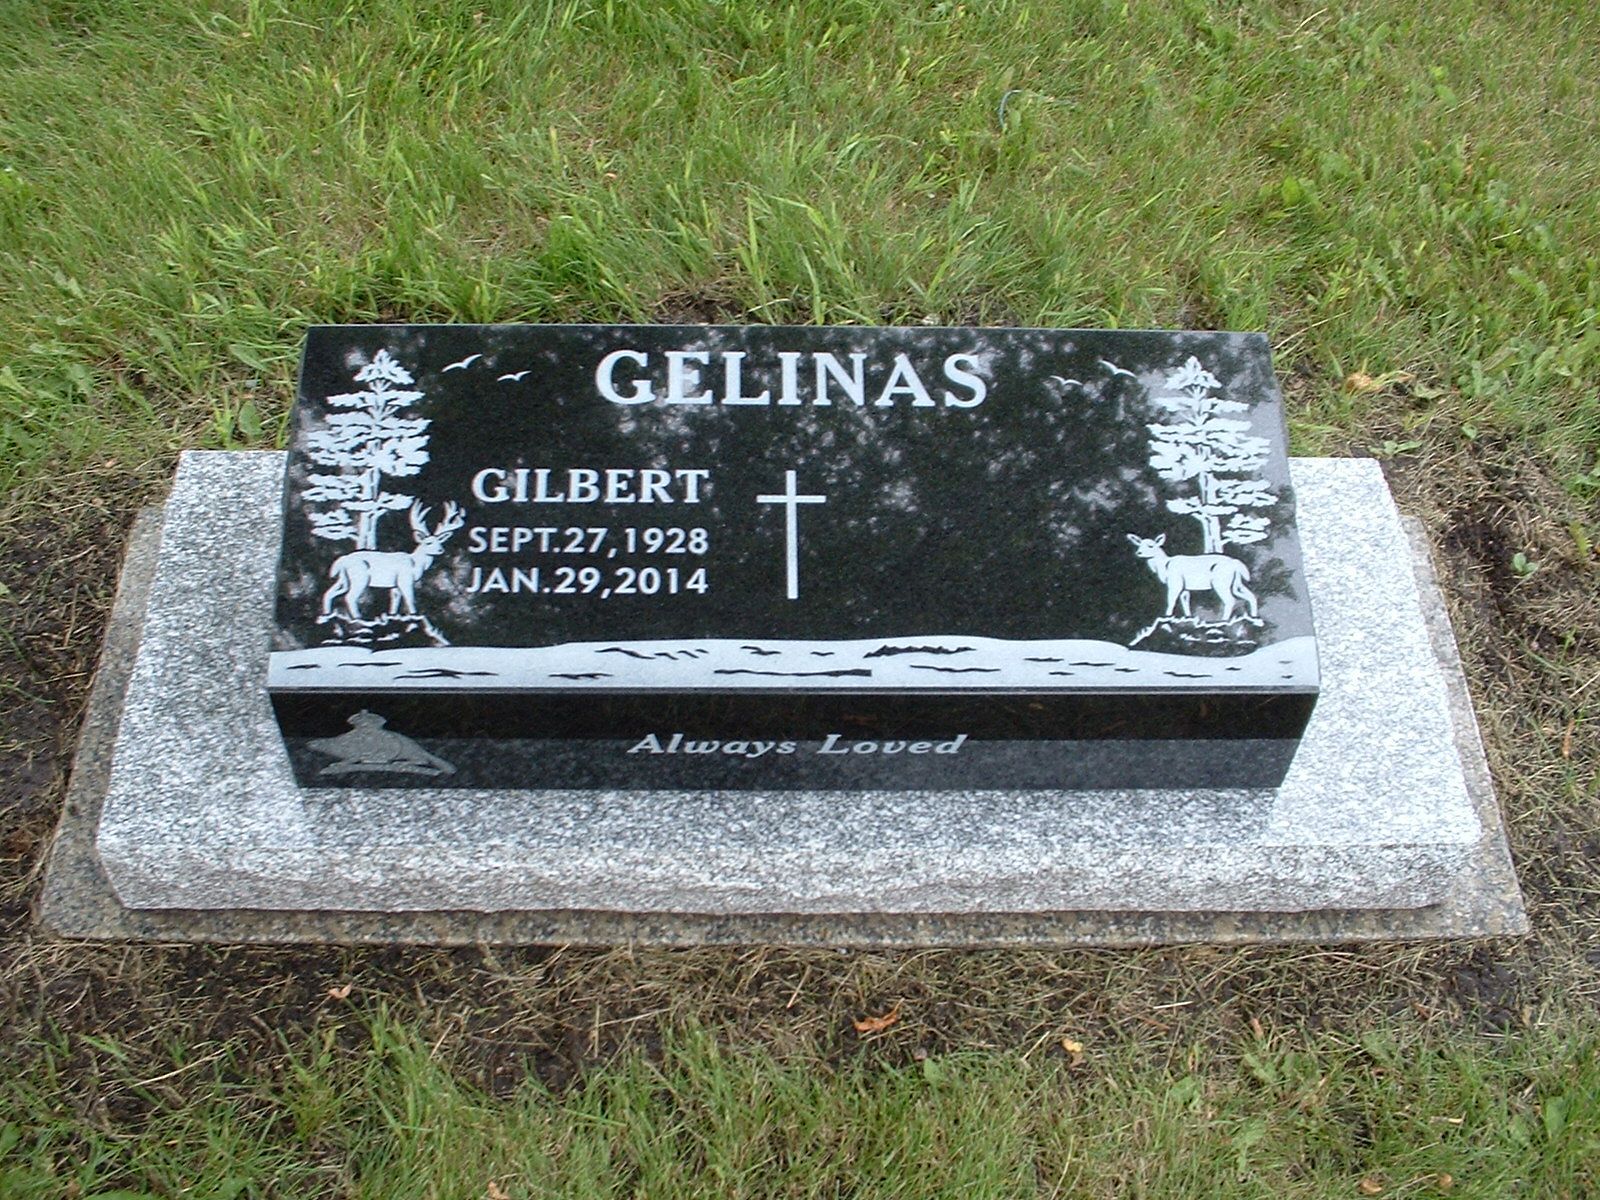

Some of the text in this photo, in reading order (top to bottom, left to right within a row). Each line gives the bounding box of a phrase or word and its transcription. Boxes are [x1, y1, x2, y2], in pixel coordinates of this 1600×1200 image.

[595, 350, 988, 409] GELINAS
[471, 468, 711, 504] GILBERT
[468, 526, 710, 559] SEPT.27,1928
[466, 566, 709, 600] JAN.29,2014
[627, 732, 969, 759] Always Loved
